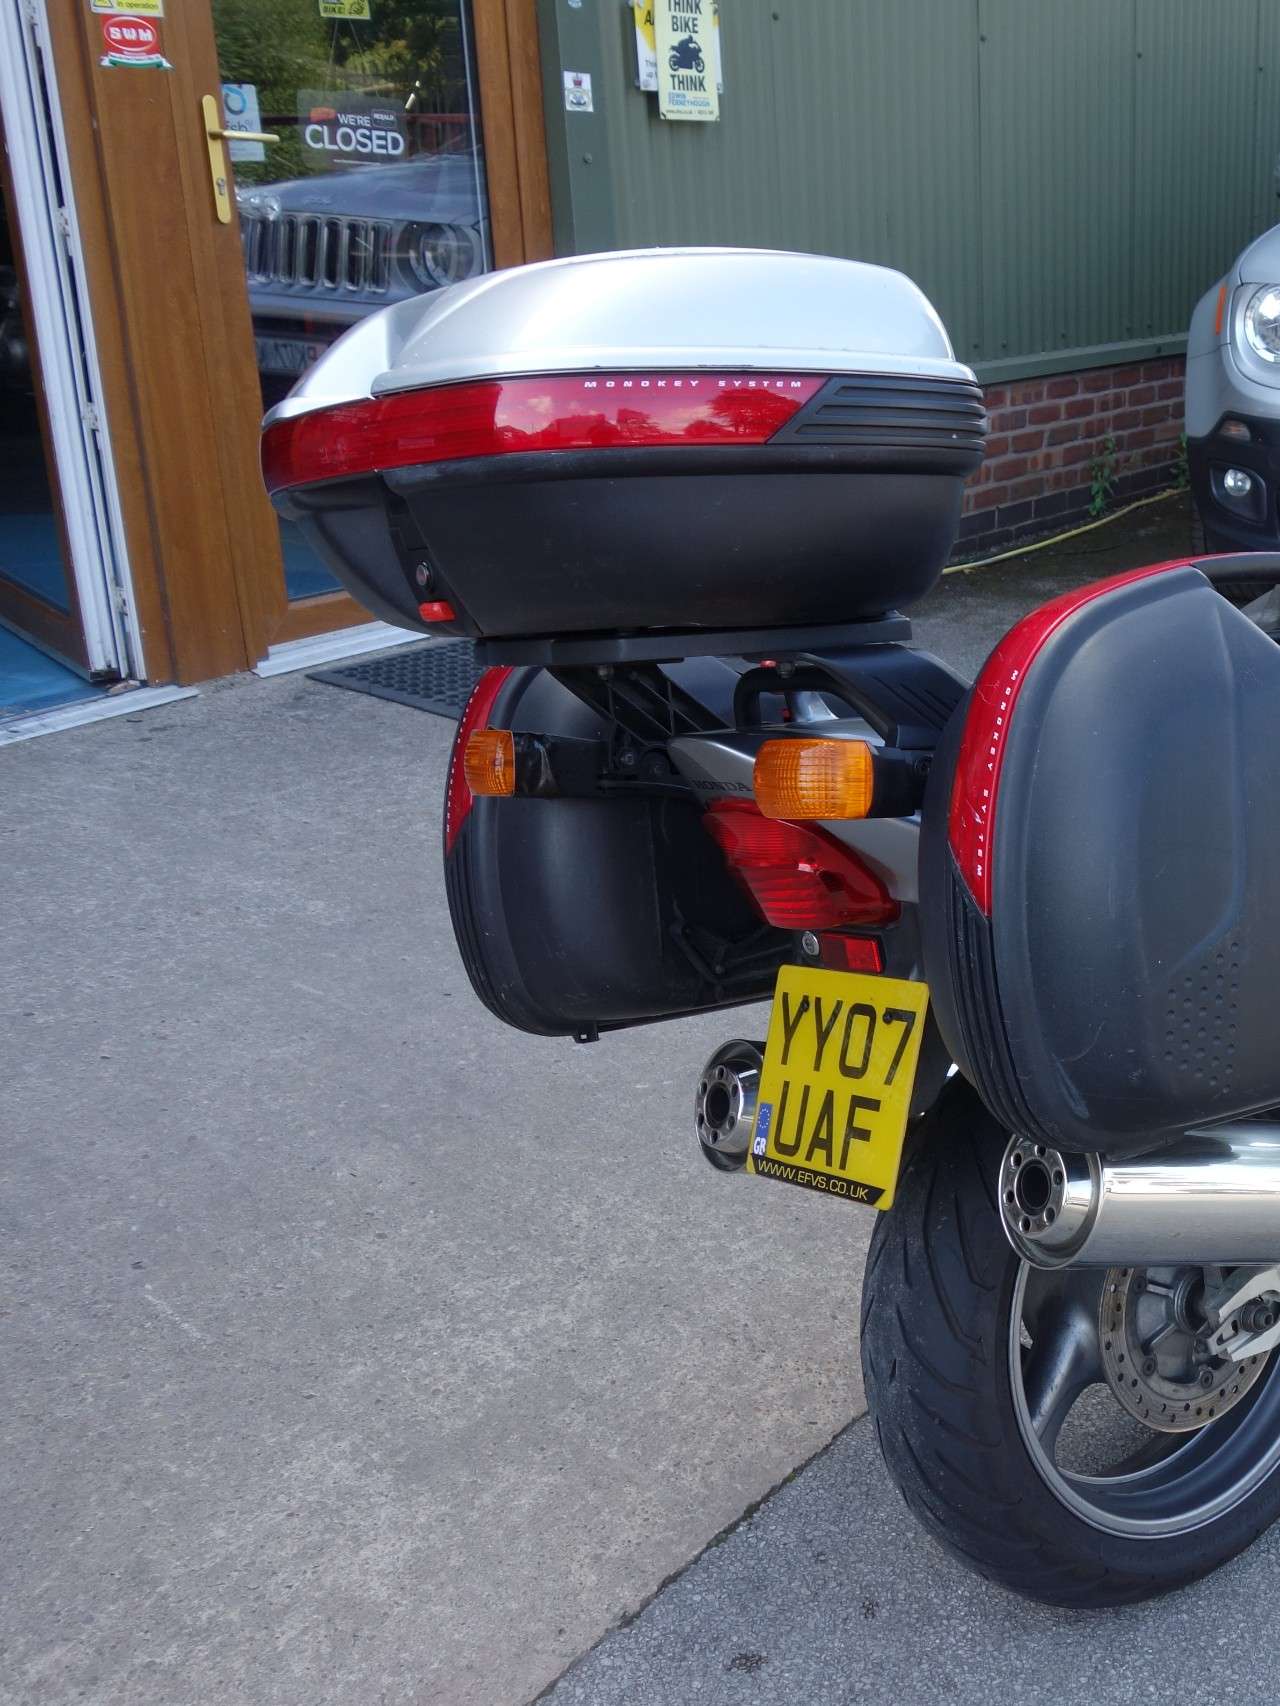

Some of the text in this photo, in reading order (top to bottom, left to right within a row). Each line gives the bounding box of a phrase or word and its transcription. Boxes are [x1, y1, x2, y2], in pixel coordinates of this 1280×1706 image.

[667, 0, 702, 14] THINK
[671, 15, 699, 33] BIKE
[109, 27, 153, 41] SWM
[670, 74, 706, 91] THINK
[337, 113, 371, 127] WE'RE
[305, 124, 405, 155] CLOSED
[584, 380, 801, 389] MONOKEY SYSTEM
[976, 669, 1019, 877] MONOKEY SYTEM
[780, 991, 917, 1086] YY07
[773, 1080, 882, 1171] UAF
[758, 1159, 869, 1201] WWW.EFVS.CO.UK
